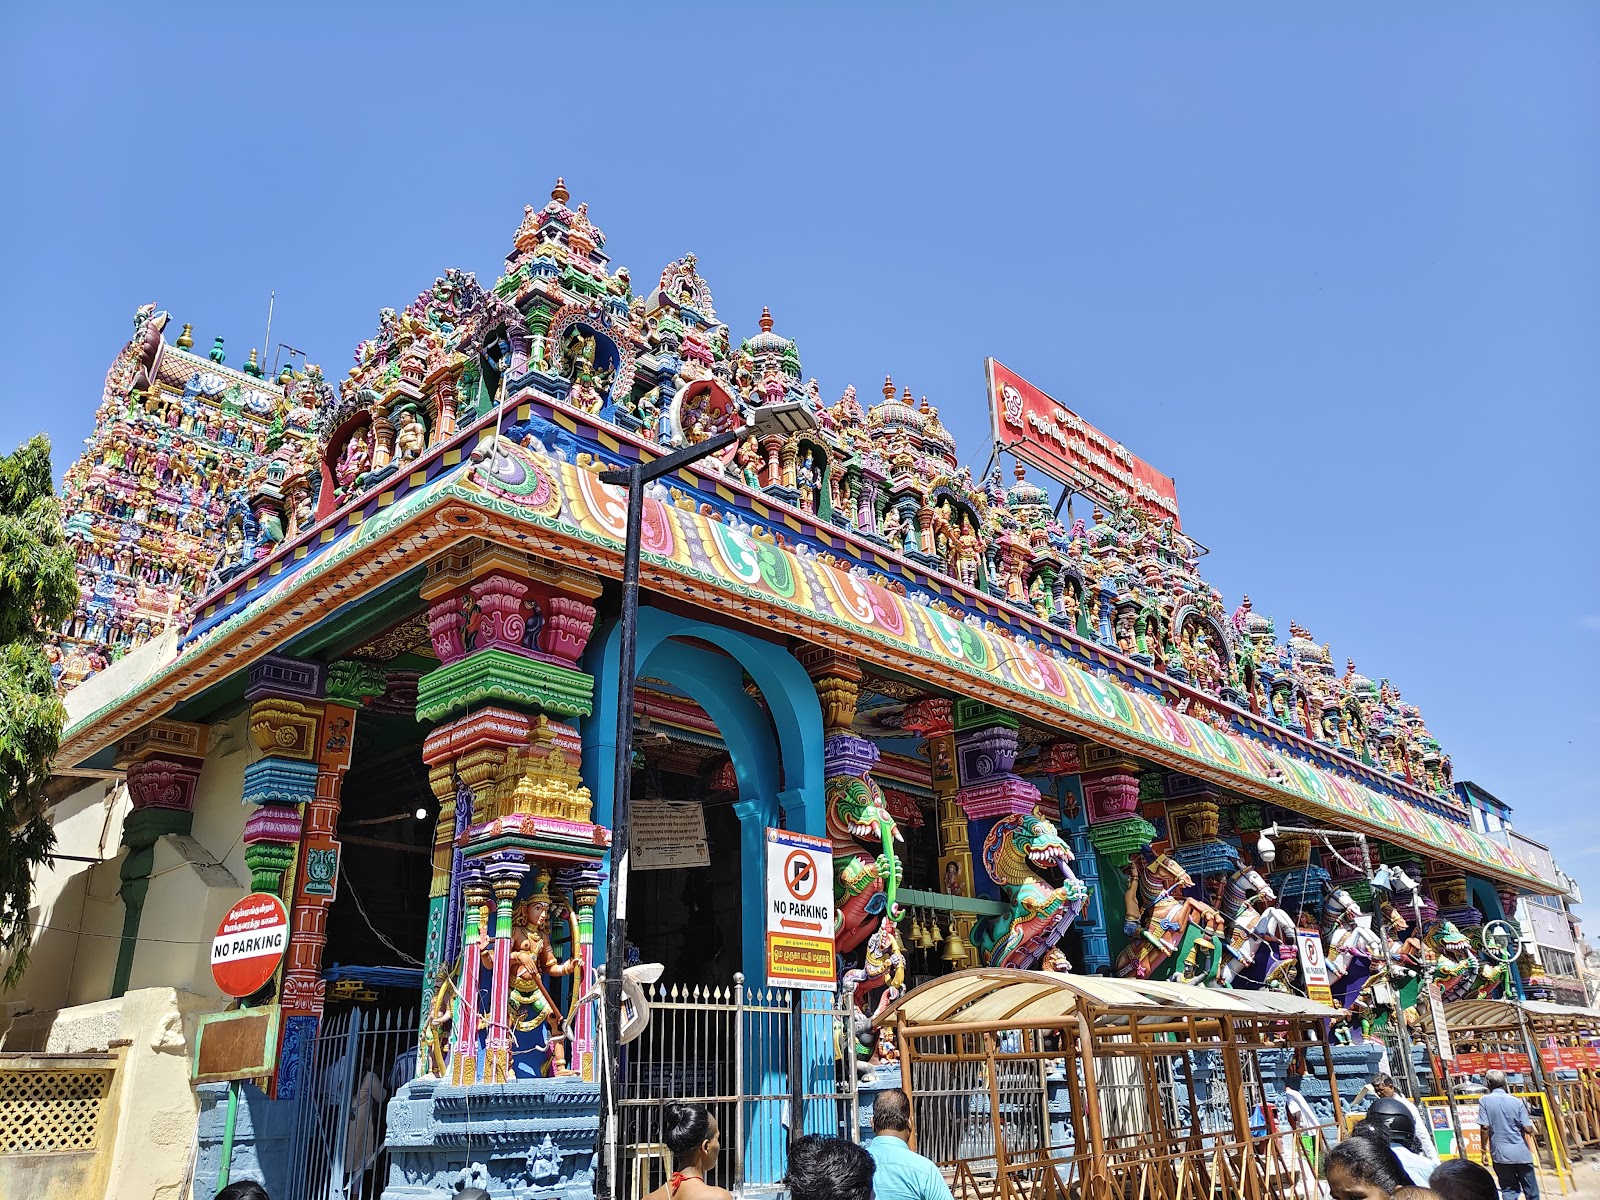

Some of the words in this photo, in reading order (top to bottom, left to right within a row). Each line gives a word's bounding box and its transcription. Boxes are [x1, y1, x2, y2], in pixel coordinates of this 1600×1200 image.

[1026, 410, 1067, 448] அருள்மிகு
[1054, 408, 1086, 434] முதல்
[1087, 429, 1112, 451] படை
[1112, 445, 1134, 468] வீடு
[229, 901, 275, 921] திருப்பரங்குன்றம்
[773, 900, 787, 915] NO
[789, 902, 828, 920] PARKING
[224, 918, 261, 933] போக்குவரத்து
[261, 914, 279, 925] காவல்
[214, 943, 229, 958] NO
[232, 933, 282, 955] PARKING
[774, 948, 783, 961] ஓம்
[784, 951, 800, 961] முருகா
